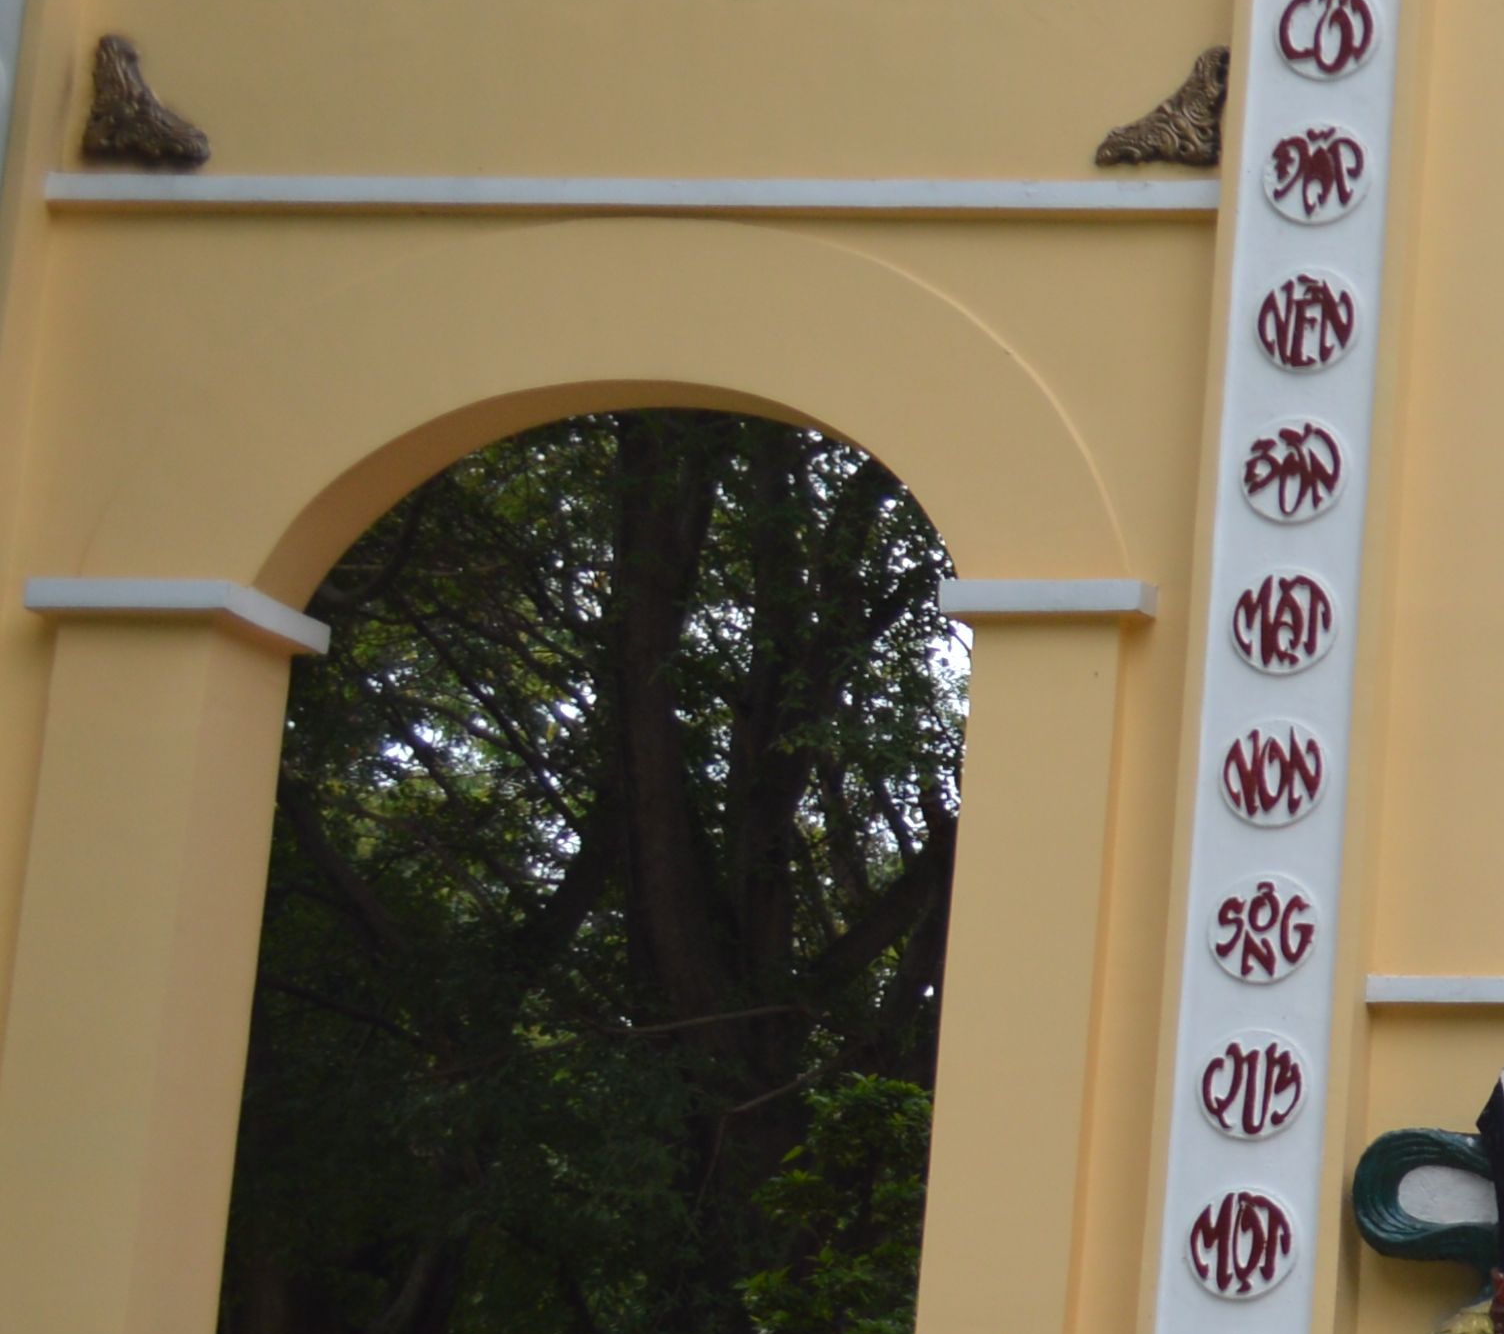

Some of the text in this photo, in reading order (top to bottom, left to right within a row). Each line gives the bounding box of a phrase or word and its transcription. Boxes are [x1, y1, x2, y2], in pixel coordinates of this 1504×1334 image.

[1259, 275, 1354, 366] NỀN
[1223, 730, 1323, 816] NON
[1216, 882, 1314, 976] SÔNG
[1190, 1193, 1291, 1292] MỘT
